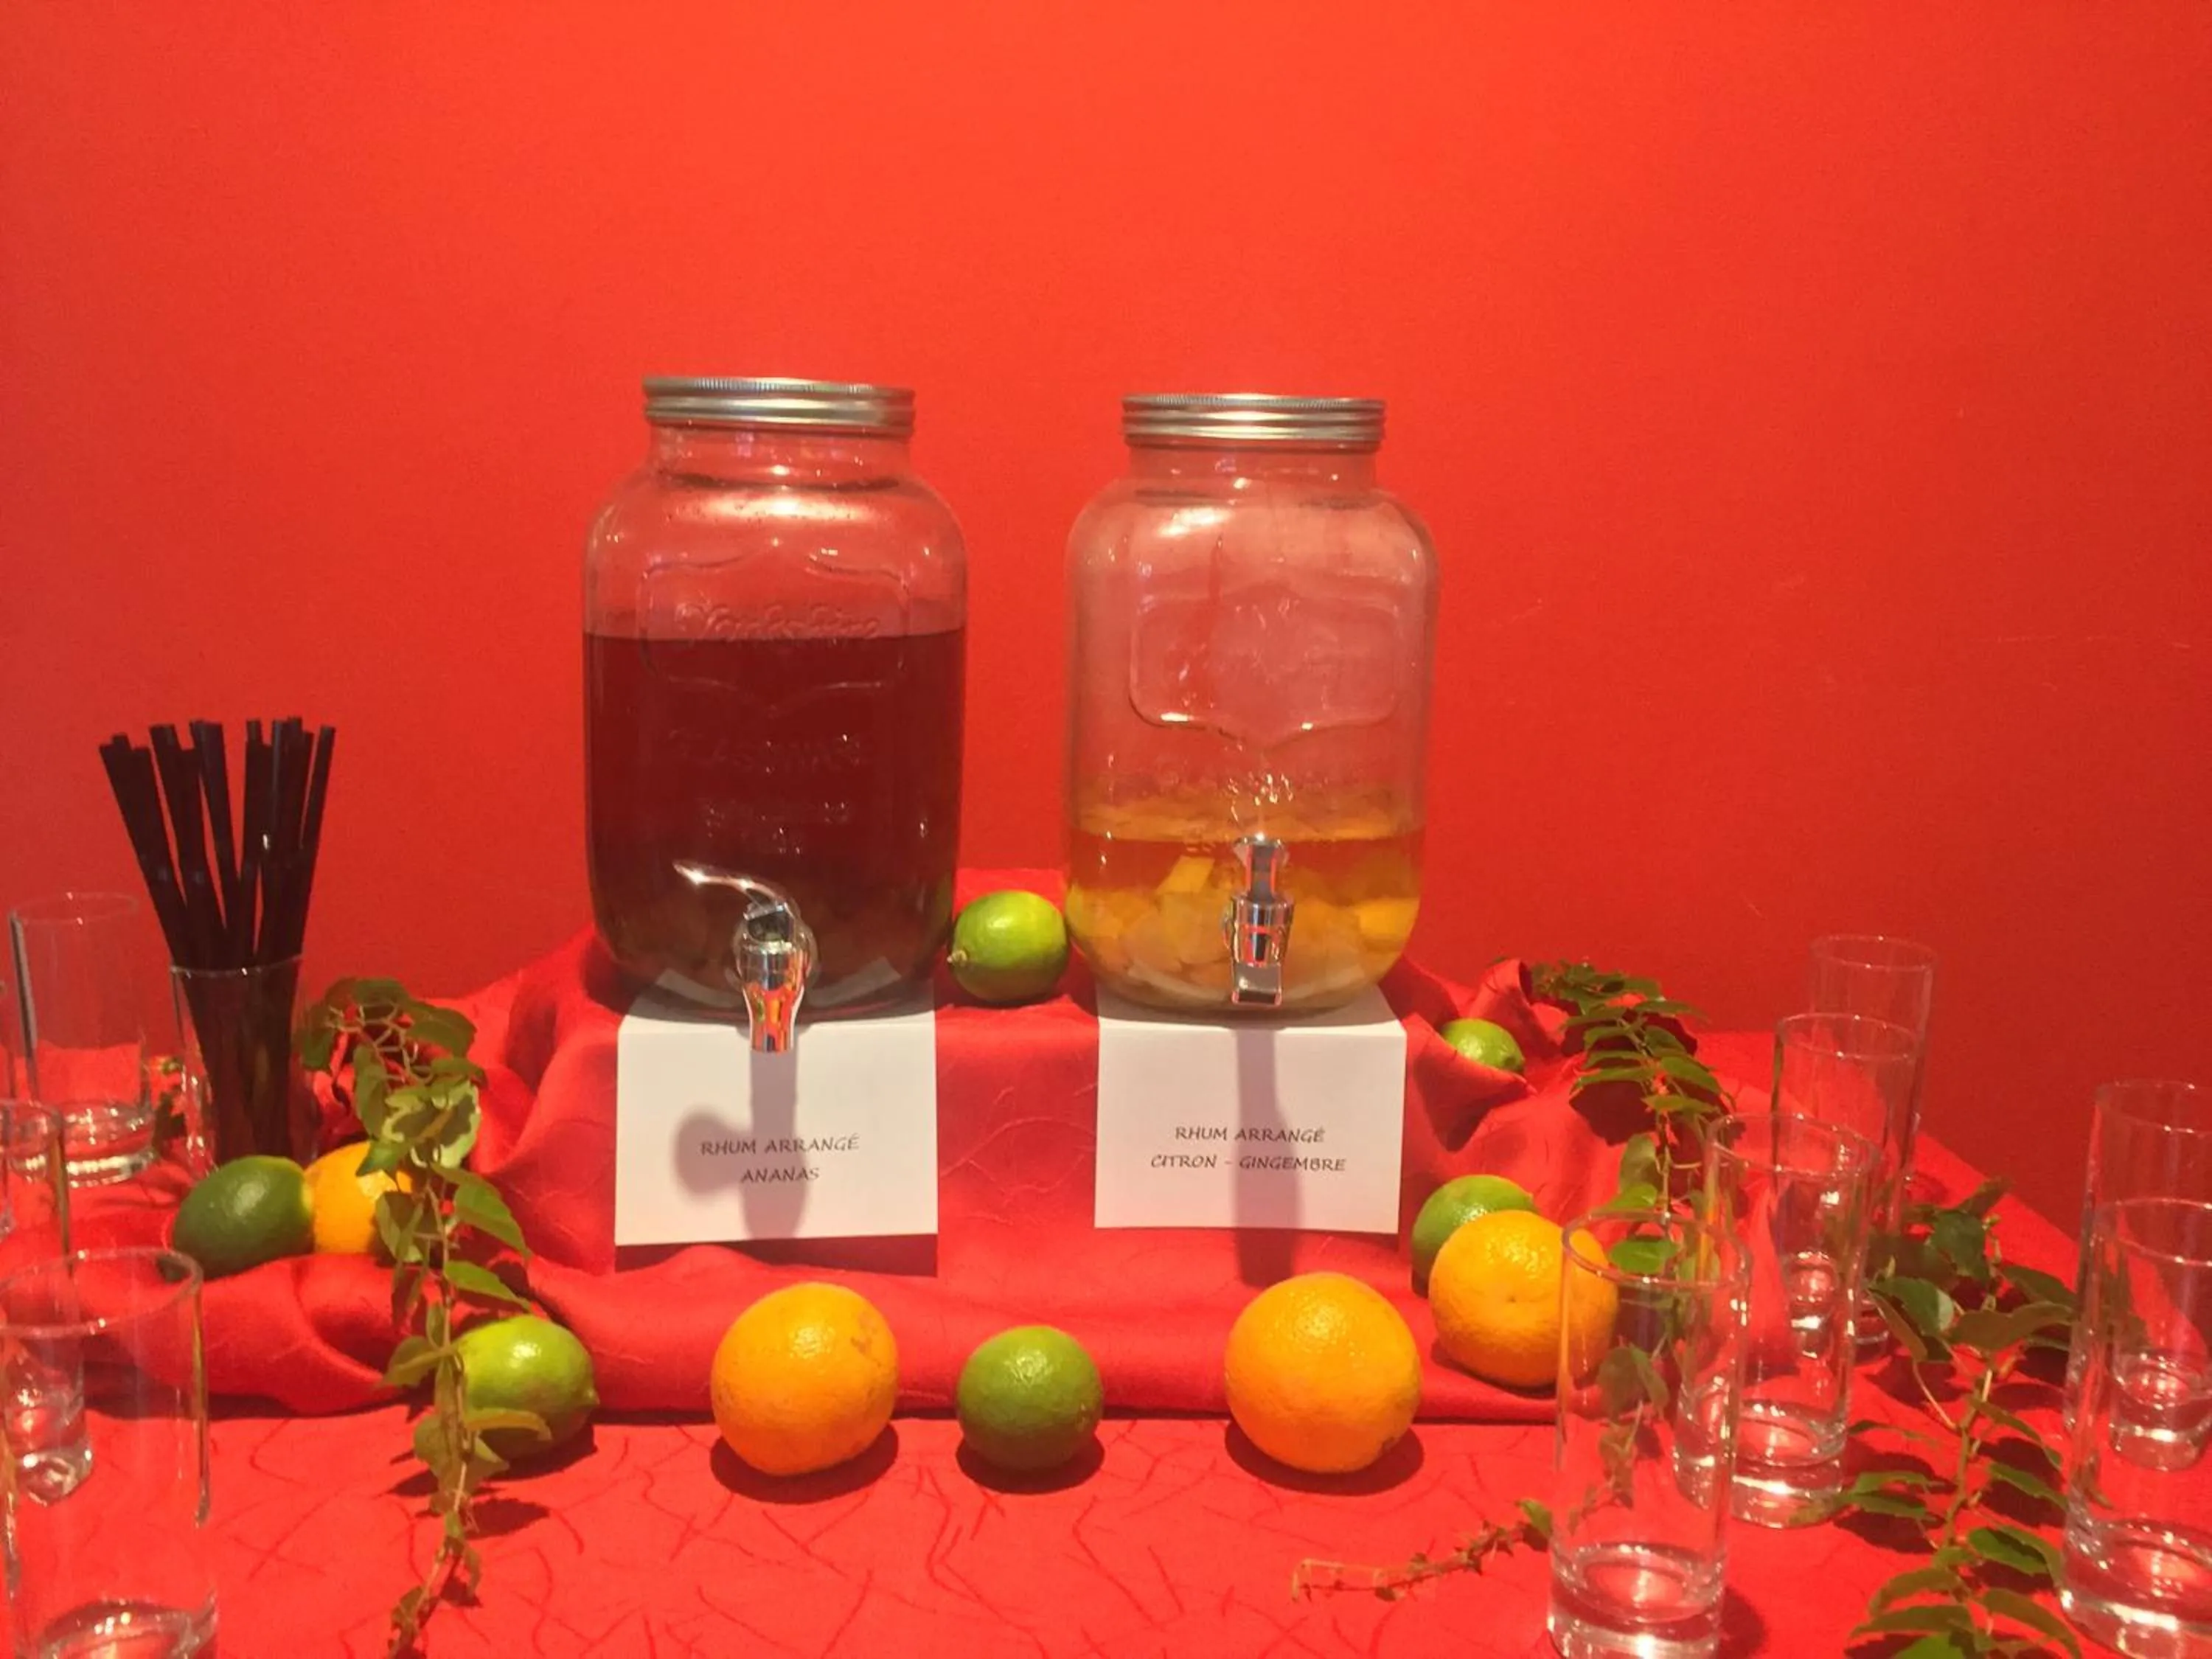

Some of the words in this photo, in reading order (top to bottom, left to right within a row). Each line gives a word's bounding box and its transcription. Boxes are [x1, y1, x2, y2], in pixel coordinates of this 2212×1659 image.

[700, 1138, 757, 1156] RHUM
[765, 1132, 860, 1154] ARRANGÉ
[1175, 1126, 1227, 1141] RHUM
[1234, 1127, 1326, 1144] ARRANGÉ
[1151, 1154, 1217, 1169] CITRON
[1239, 1155, 1346, 1171] GINGEMBRE
[740, 1166, 819, 1184] ANANAS
